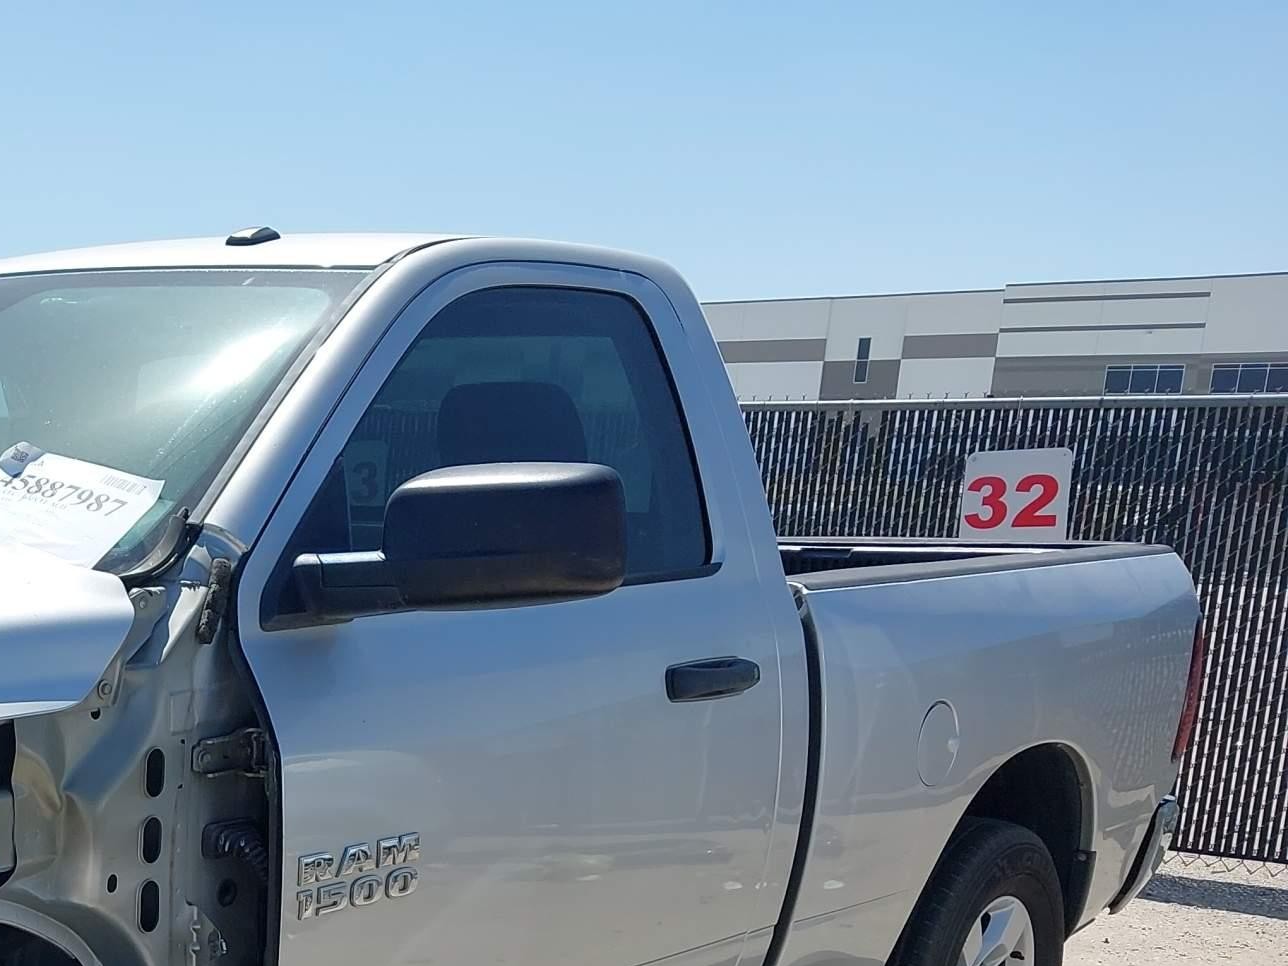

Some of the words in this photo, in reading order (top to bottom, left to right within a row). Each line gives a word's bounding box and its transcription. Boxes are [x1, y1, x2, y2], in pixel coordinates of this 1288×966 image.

[0, 474, 129, 517] 45887987
[964, 474, 1059, 530] 32
[297, 832, 421, 887] RAM
[297, 866, 419, 921] 1500
